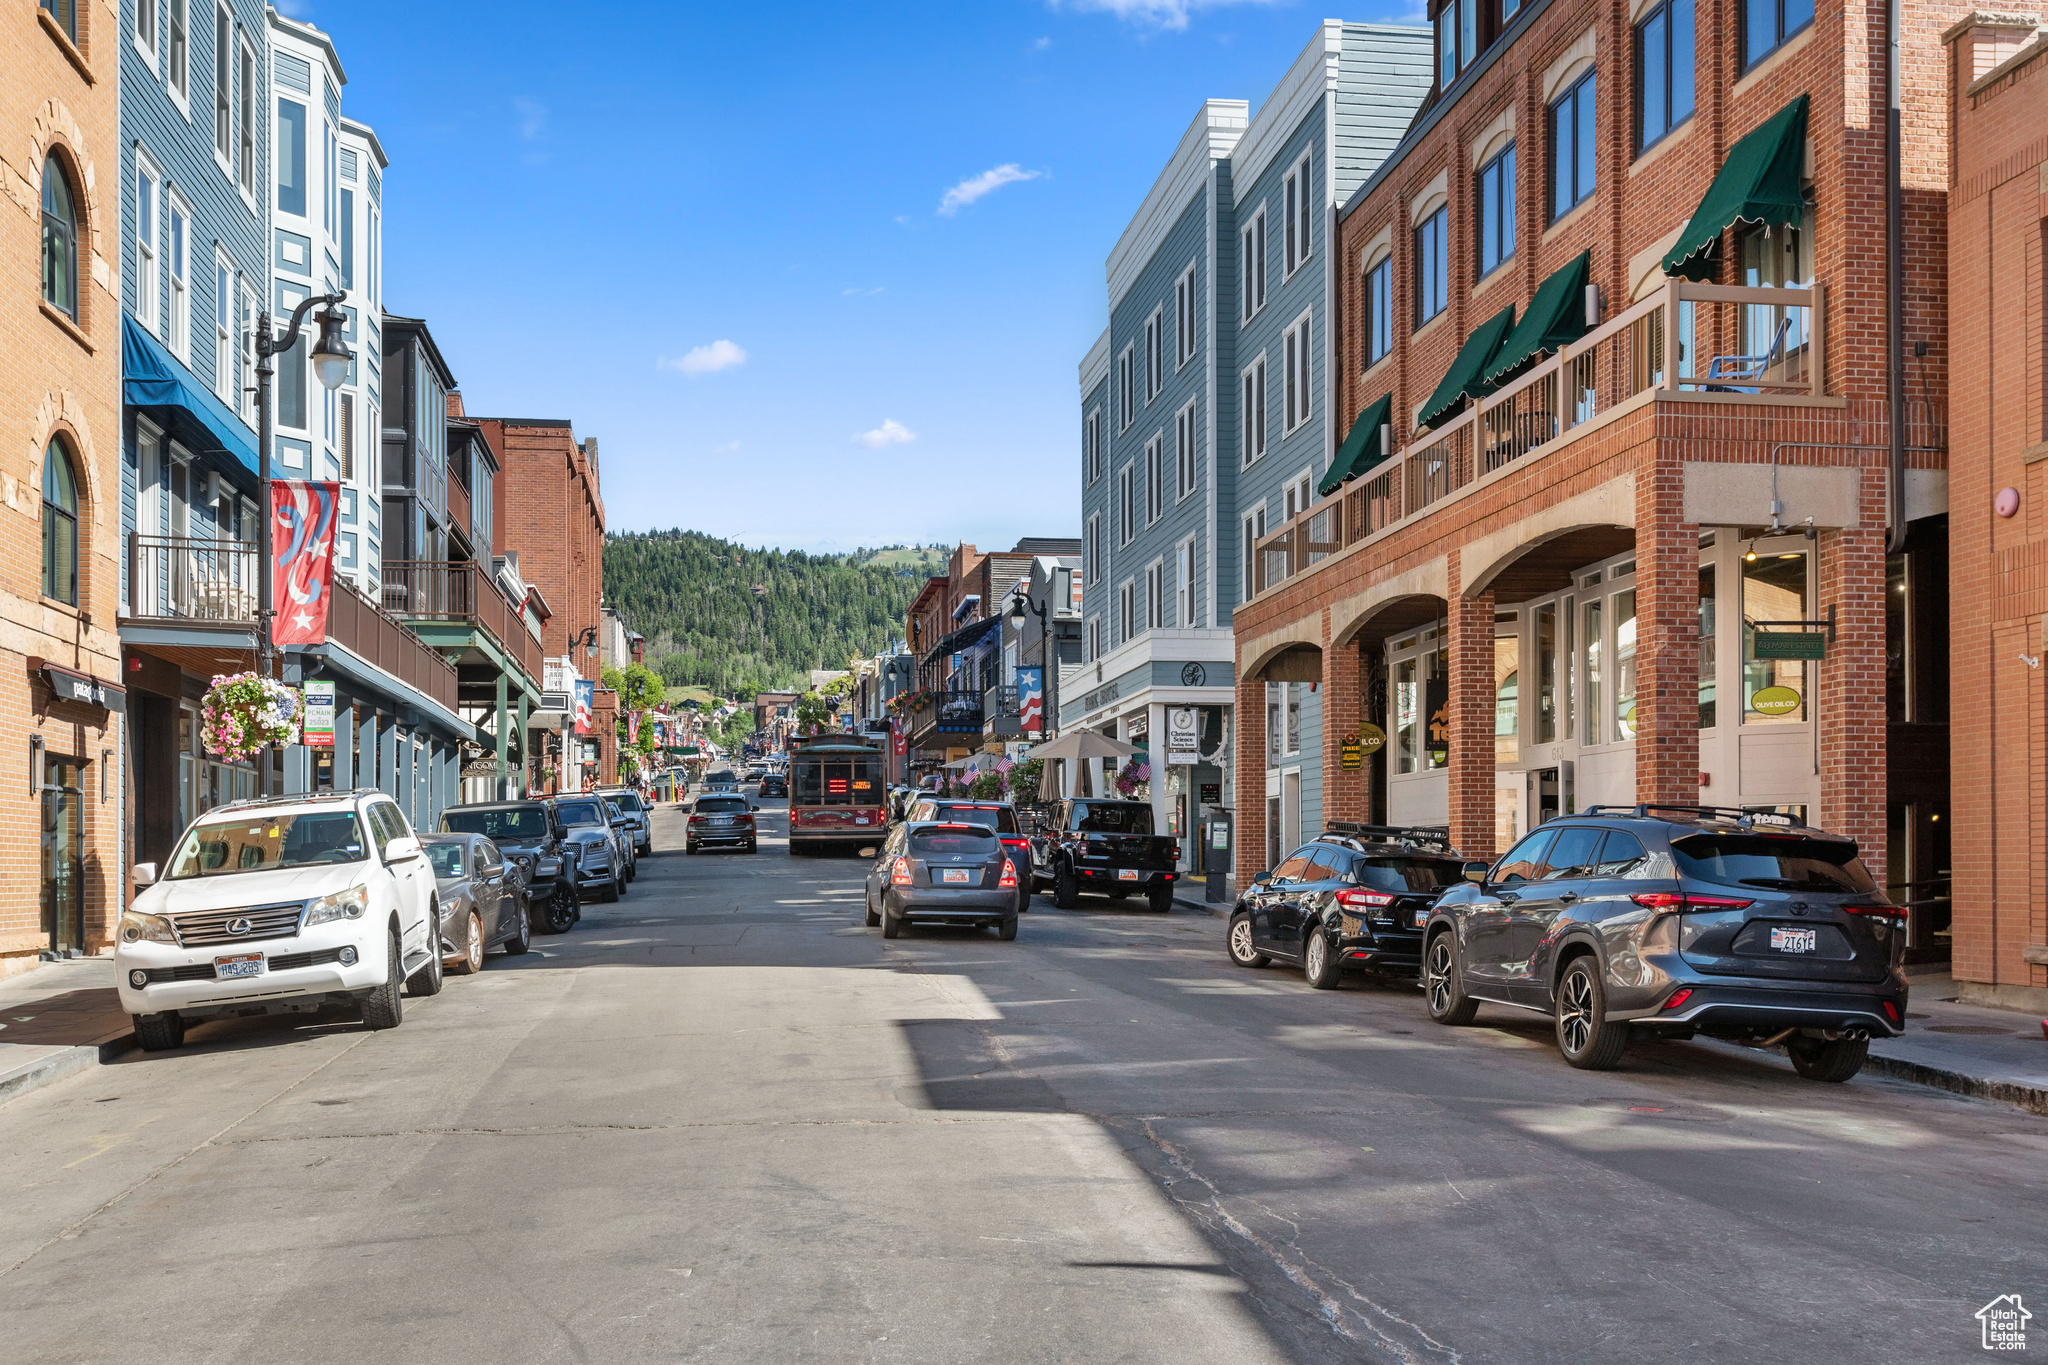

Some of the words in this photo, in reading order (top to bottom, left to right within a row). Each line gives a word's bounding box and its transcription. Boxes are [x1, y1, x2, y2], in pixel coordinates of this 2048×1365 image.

[73, 681, 105, 703] patagonia
[1368, 737, 1381, 745] CO.
[1551, 747, 1565, 760] 613
